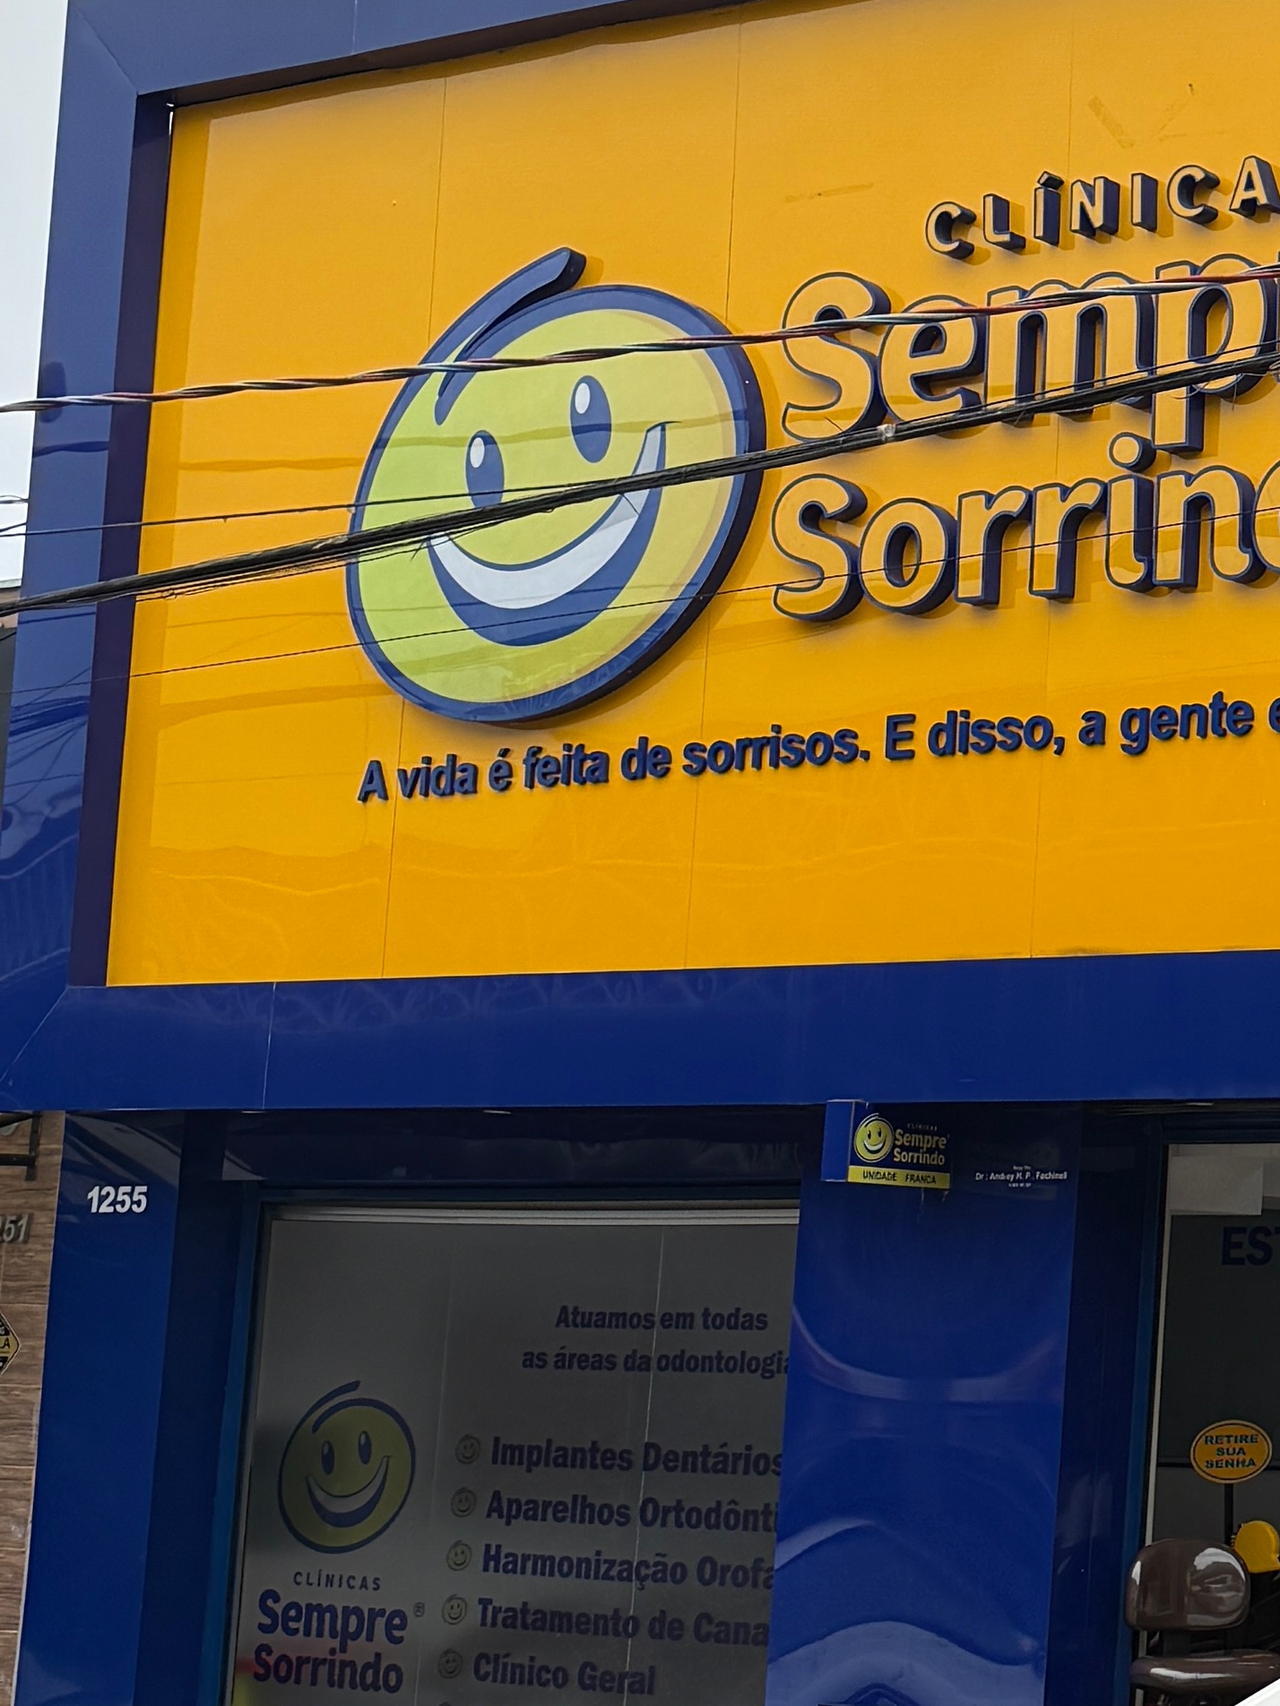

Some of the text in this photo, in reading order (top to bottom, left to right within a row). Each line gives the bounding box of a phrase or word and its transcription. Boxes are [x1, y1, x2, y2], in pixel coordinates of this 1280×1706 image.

[357, 759, 389, 803] A
[396, 753, 478, 800] vida
[488, 747, 513, 792] é
[522, 742, 610, 790] feita
[620, 736, 671, 782] de
[682, 723, 871, 778] sorrisos.
[884, 713, 916, 761] E
[927, 709, 1066, 758] disso,
[1077, 710, 1106, 747] a
[1119, 691, 1255, 756] gente
[894, 1129, 947, 1152] Sempre
[893, 1148, 945, 1165] Sorrindo
[863, 1170, 937, 1185] UNIDADE FRANCA
[87, 1185, 148, 1213] 1255
[0, 1214, 29, 1243] 51
[555, 1305, 768, 1331] Atuamos em todas
[522, 1350, 548, 1370] as
[553, 1346, 618, 1371] áreas
[623, 1349, 652, 1372] da
[1204, 1434, 1259, 1445] RETIRE
[1216, 1447, 1246, 1456] SUA
[491, 1437, 783, 1477] Implantes Dentários
[1205, 1458, 1256, 1469] SENHA
[486, 1490, 631, 1527] Aparelhos
[293, 1569, 381, 1591] CLÍNICAS
[482, 1543, 688, 1591] Harmonização
[257, 1588, 408, 1653] Sempre
[478, 1597, 640, 1638] Tratamento
[647, 1609, 685, 1641] de
[253, 1643, 404, 1694] Sorrindo
[473, 1652, 656, 1695] Clínico Geral
